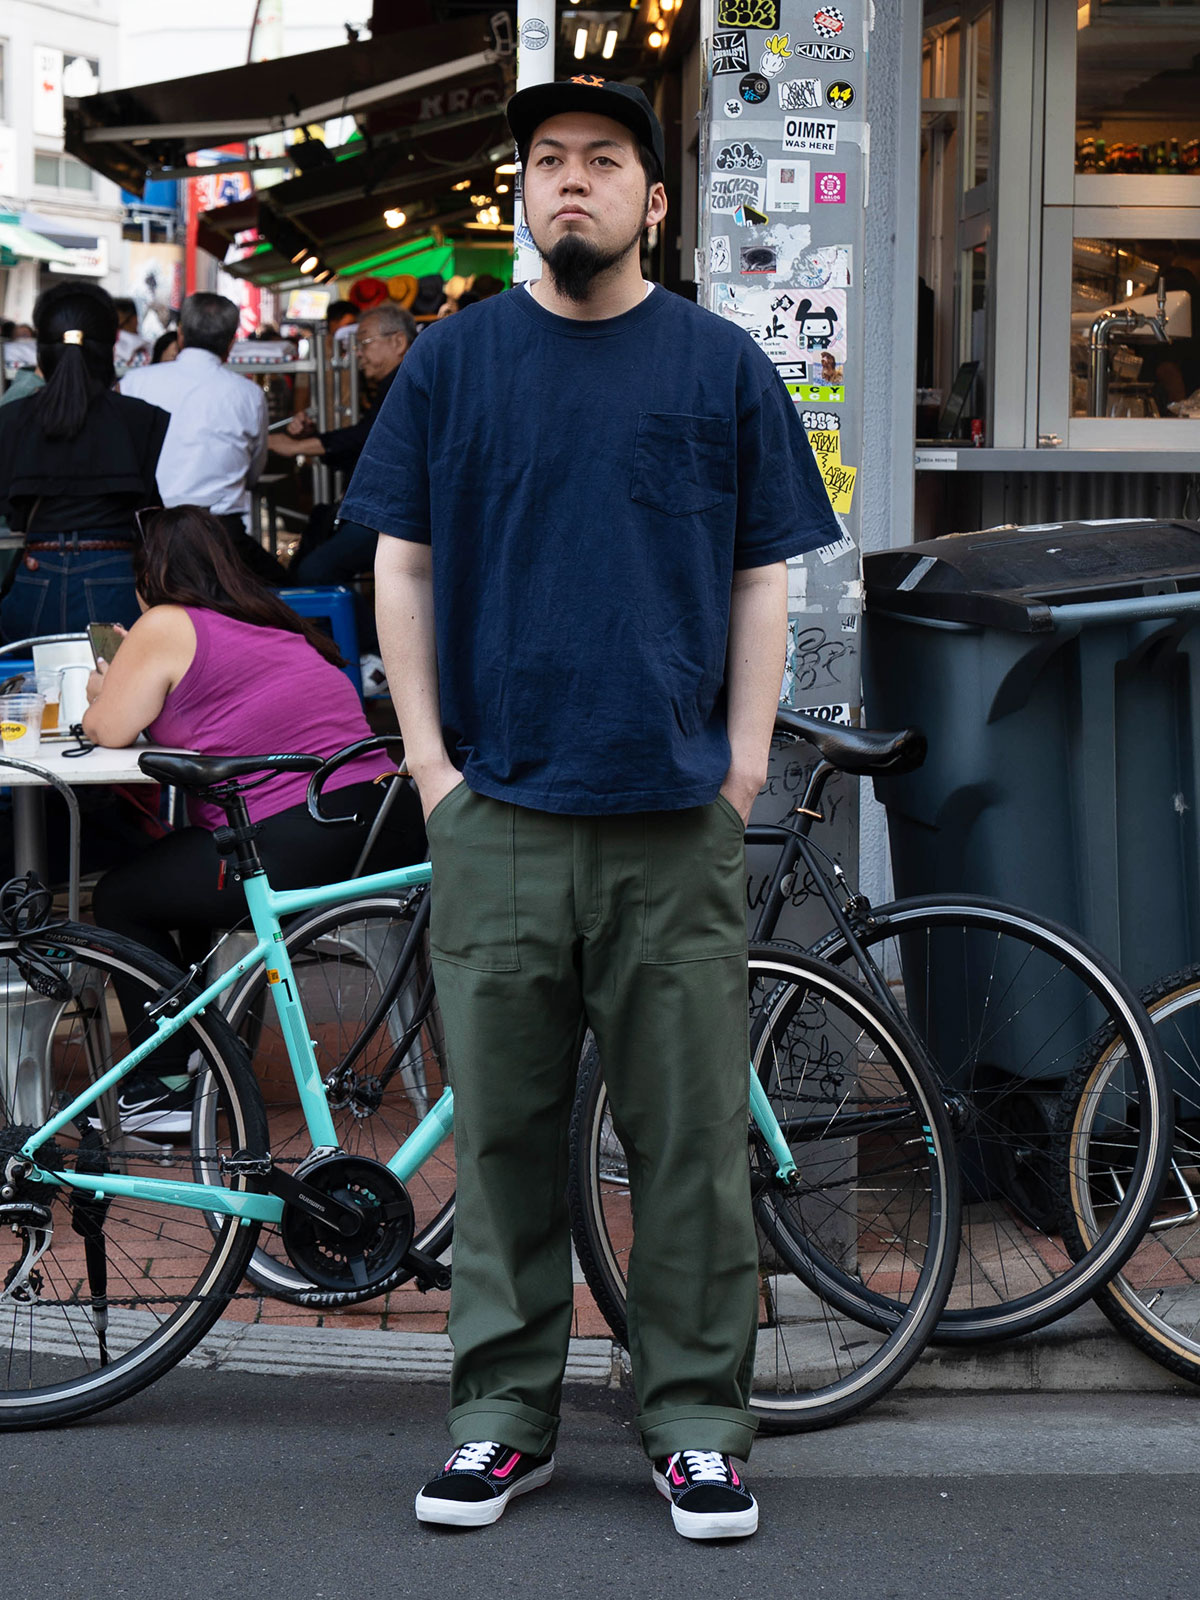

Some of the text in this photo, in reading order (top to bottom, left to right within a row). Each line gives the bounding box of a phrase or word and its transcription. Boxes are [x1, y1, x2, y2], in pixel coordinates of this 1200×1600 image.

[786, 120, 836, 140] OIMRT
[785, 140, 835, 151] WAS HERE
[711, 178, 759, 198] STICKER
[711, 193, 759, 210] ZOMBIE
[280, 977, 294, 1003] 1
